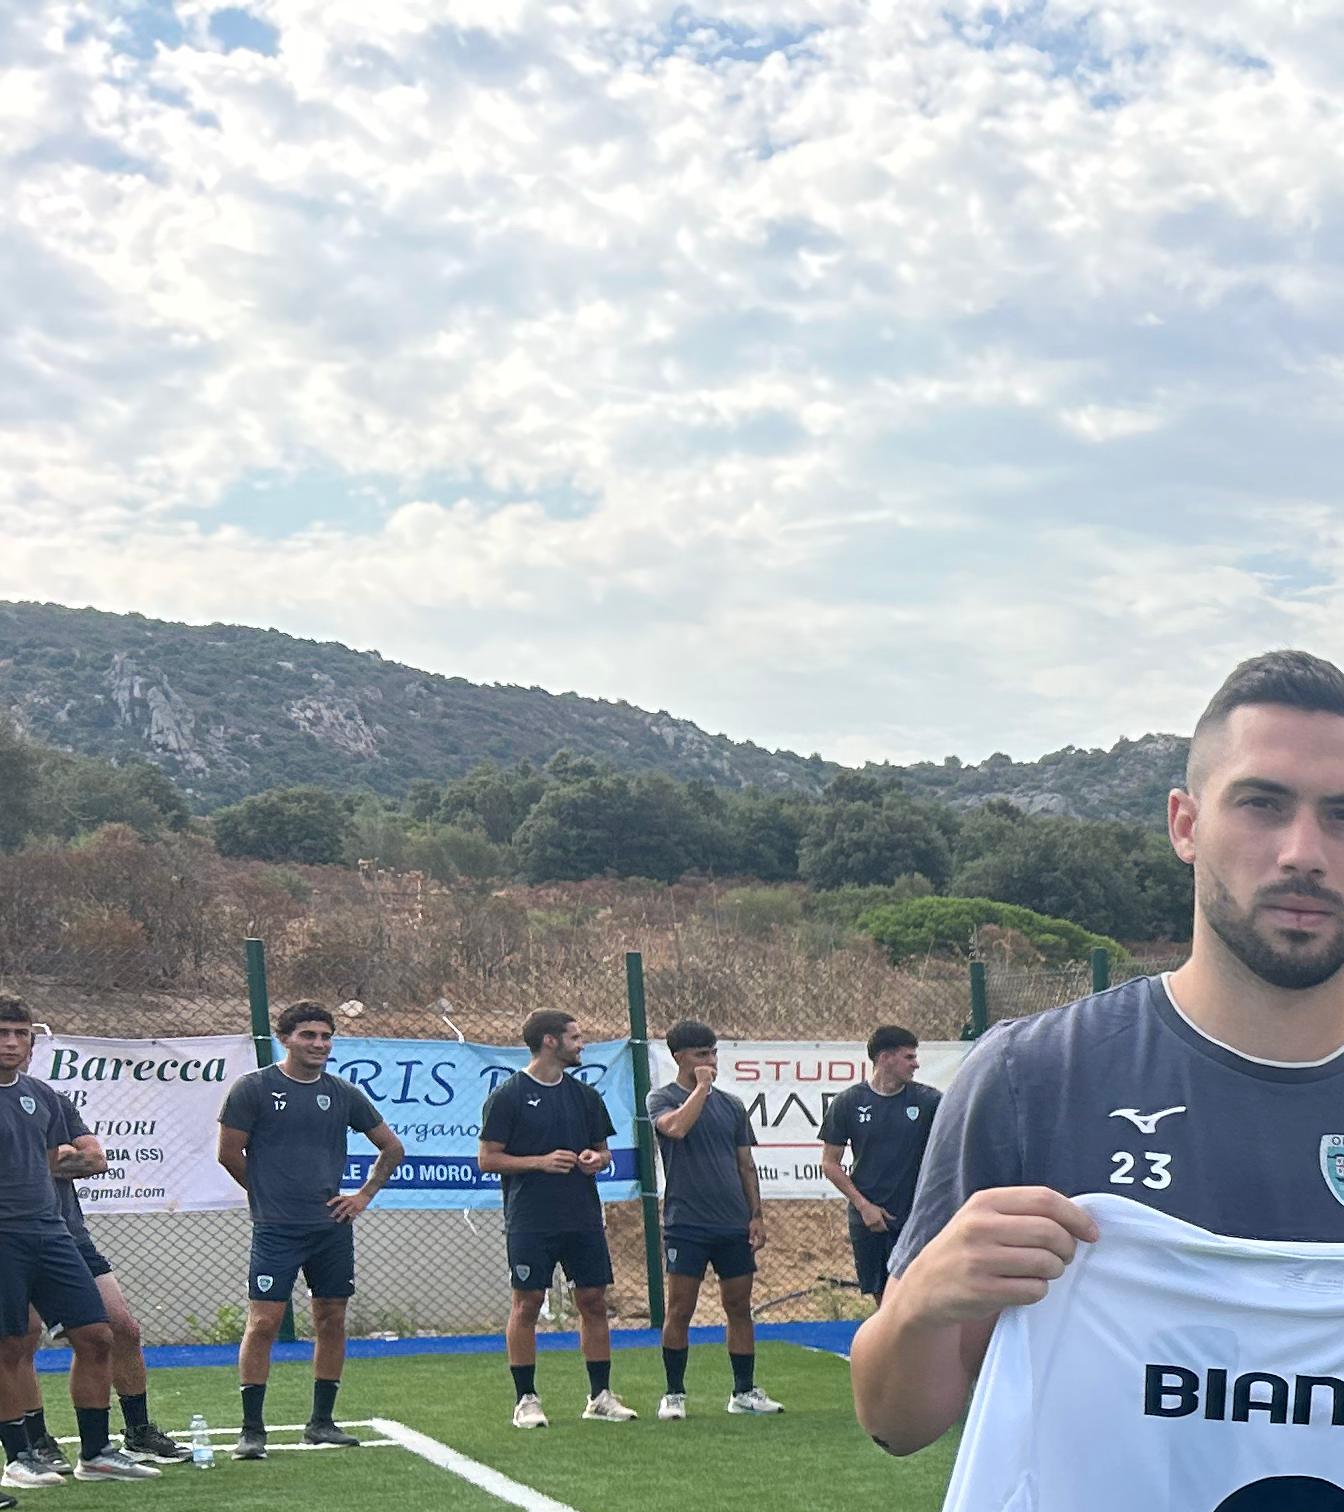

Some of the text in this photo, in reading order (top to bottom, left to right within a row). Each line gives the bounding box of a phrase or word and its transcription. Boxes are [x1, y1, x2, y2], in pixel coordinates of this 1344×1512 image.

[48, 1048, 227, 1083] Barecca
[734, 1060, 866, 1082] STUDI
[327, 1058, 456, 1107] RIS
[274, 1100, 287, 1111] 17
[94, 1119, 157, 1137] FIORI
[390, 1121, 481, 1143] argano
[105, 1148, 164, 1164] BIA (SS)
[420, 1164, 477, 1184] MORO,
[758, 1165, 778, 1180] ttu
[1108, 1151, 1172, 1190] 23
[77, 1186, 165, 1201] @gmail.com
